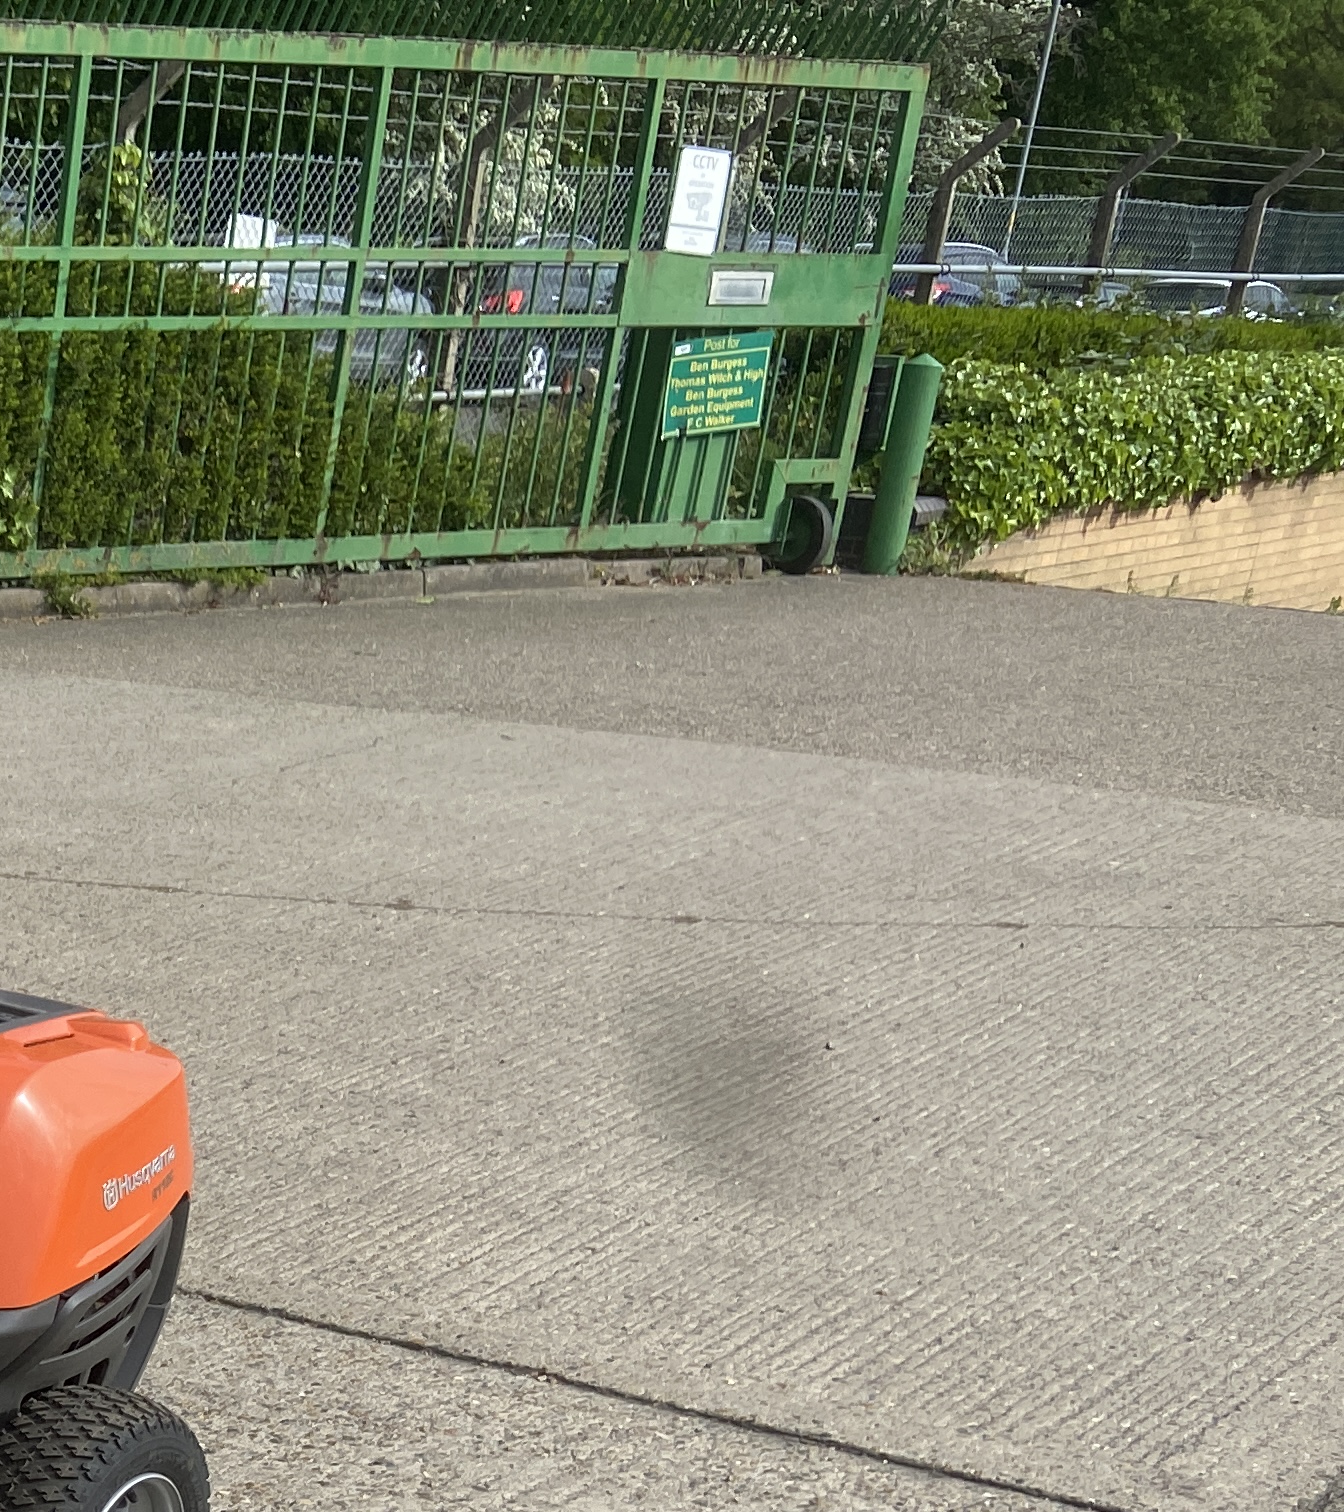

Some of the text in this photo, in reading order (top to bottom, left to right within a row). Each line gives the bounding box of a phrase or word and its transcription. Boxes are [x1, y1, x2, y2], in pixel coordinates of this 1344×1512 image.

[693, 154, 719, 170] CCTV
[704, 338, 740, 352] Post for
[690, 357, 747, 372] Ben Burgess
[671, 377, 706, 389] Thomas
[735, 370, 742, 381] &
[743, 368, 764, 383] High
[685, 386, 743, 402] Ben Burgess
[670, 397, 754, 417] Garden Equipment
[705, 414, 735, 427] Walker
[118, 1145, 175, 1200] Husqvarna
